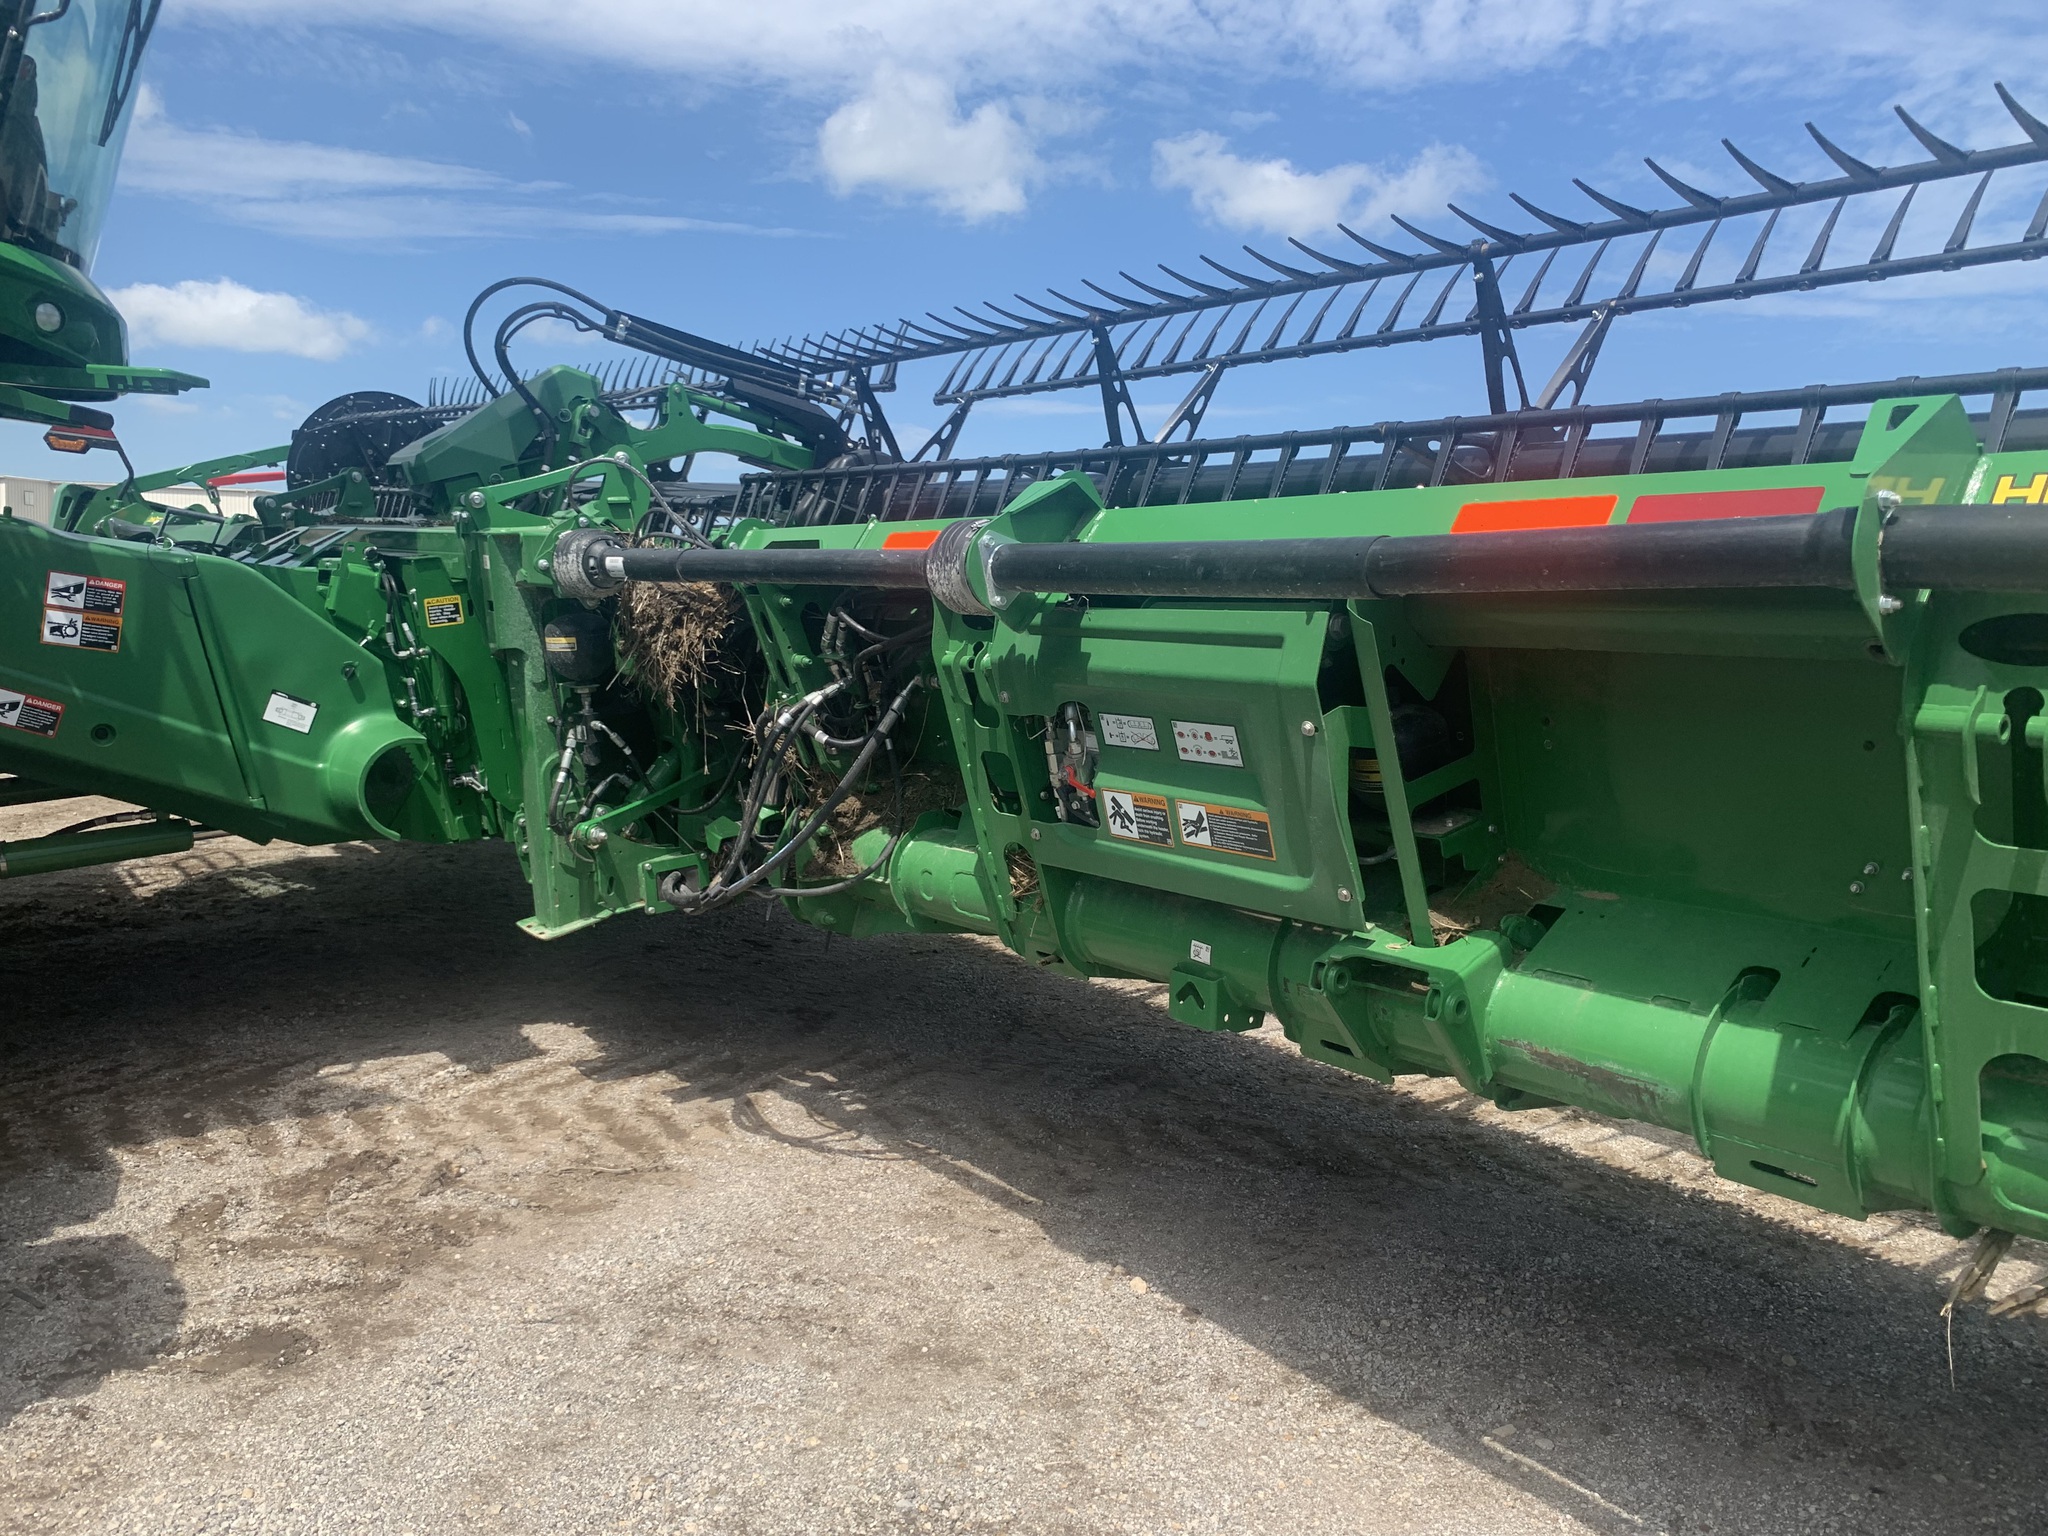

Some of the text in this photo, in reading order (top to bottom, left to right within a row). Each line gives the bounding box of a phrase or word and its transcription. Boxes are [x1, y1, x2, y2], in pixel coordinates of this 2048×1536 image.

[1992, 474, 2048, 504] H
[95, 580, 123, 589] DANGER
[90, 616, 119, 625] WARNING
[32, 699, 62, 711] DANGER
[1139, 796, 1166, 806] WARNING
[1225, 810, 1252, 818] WARNING
